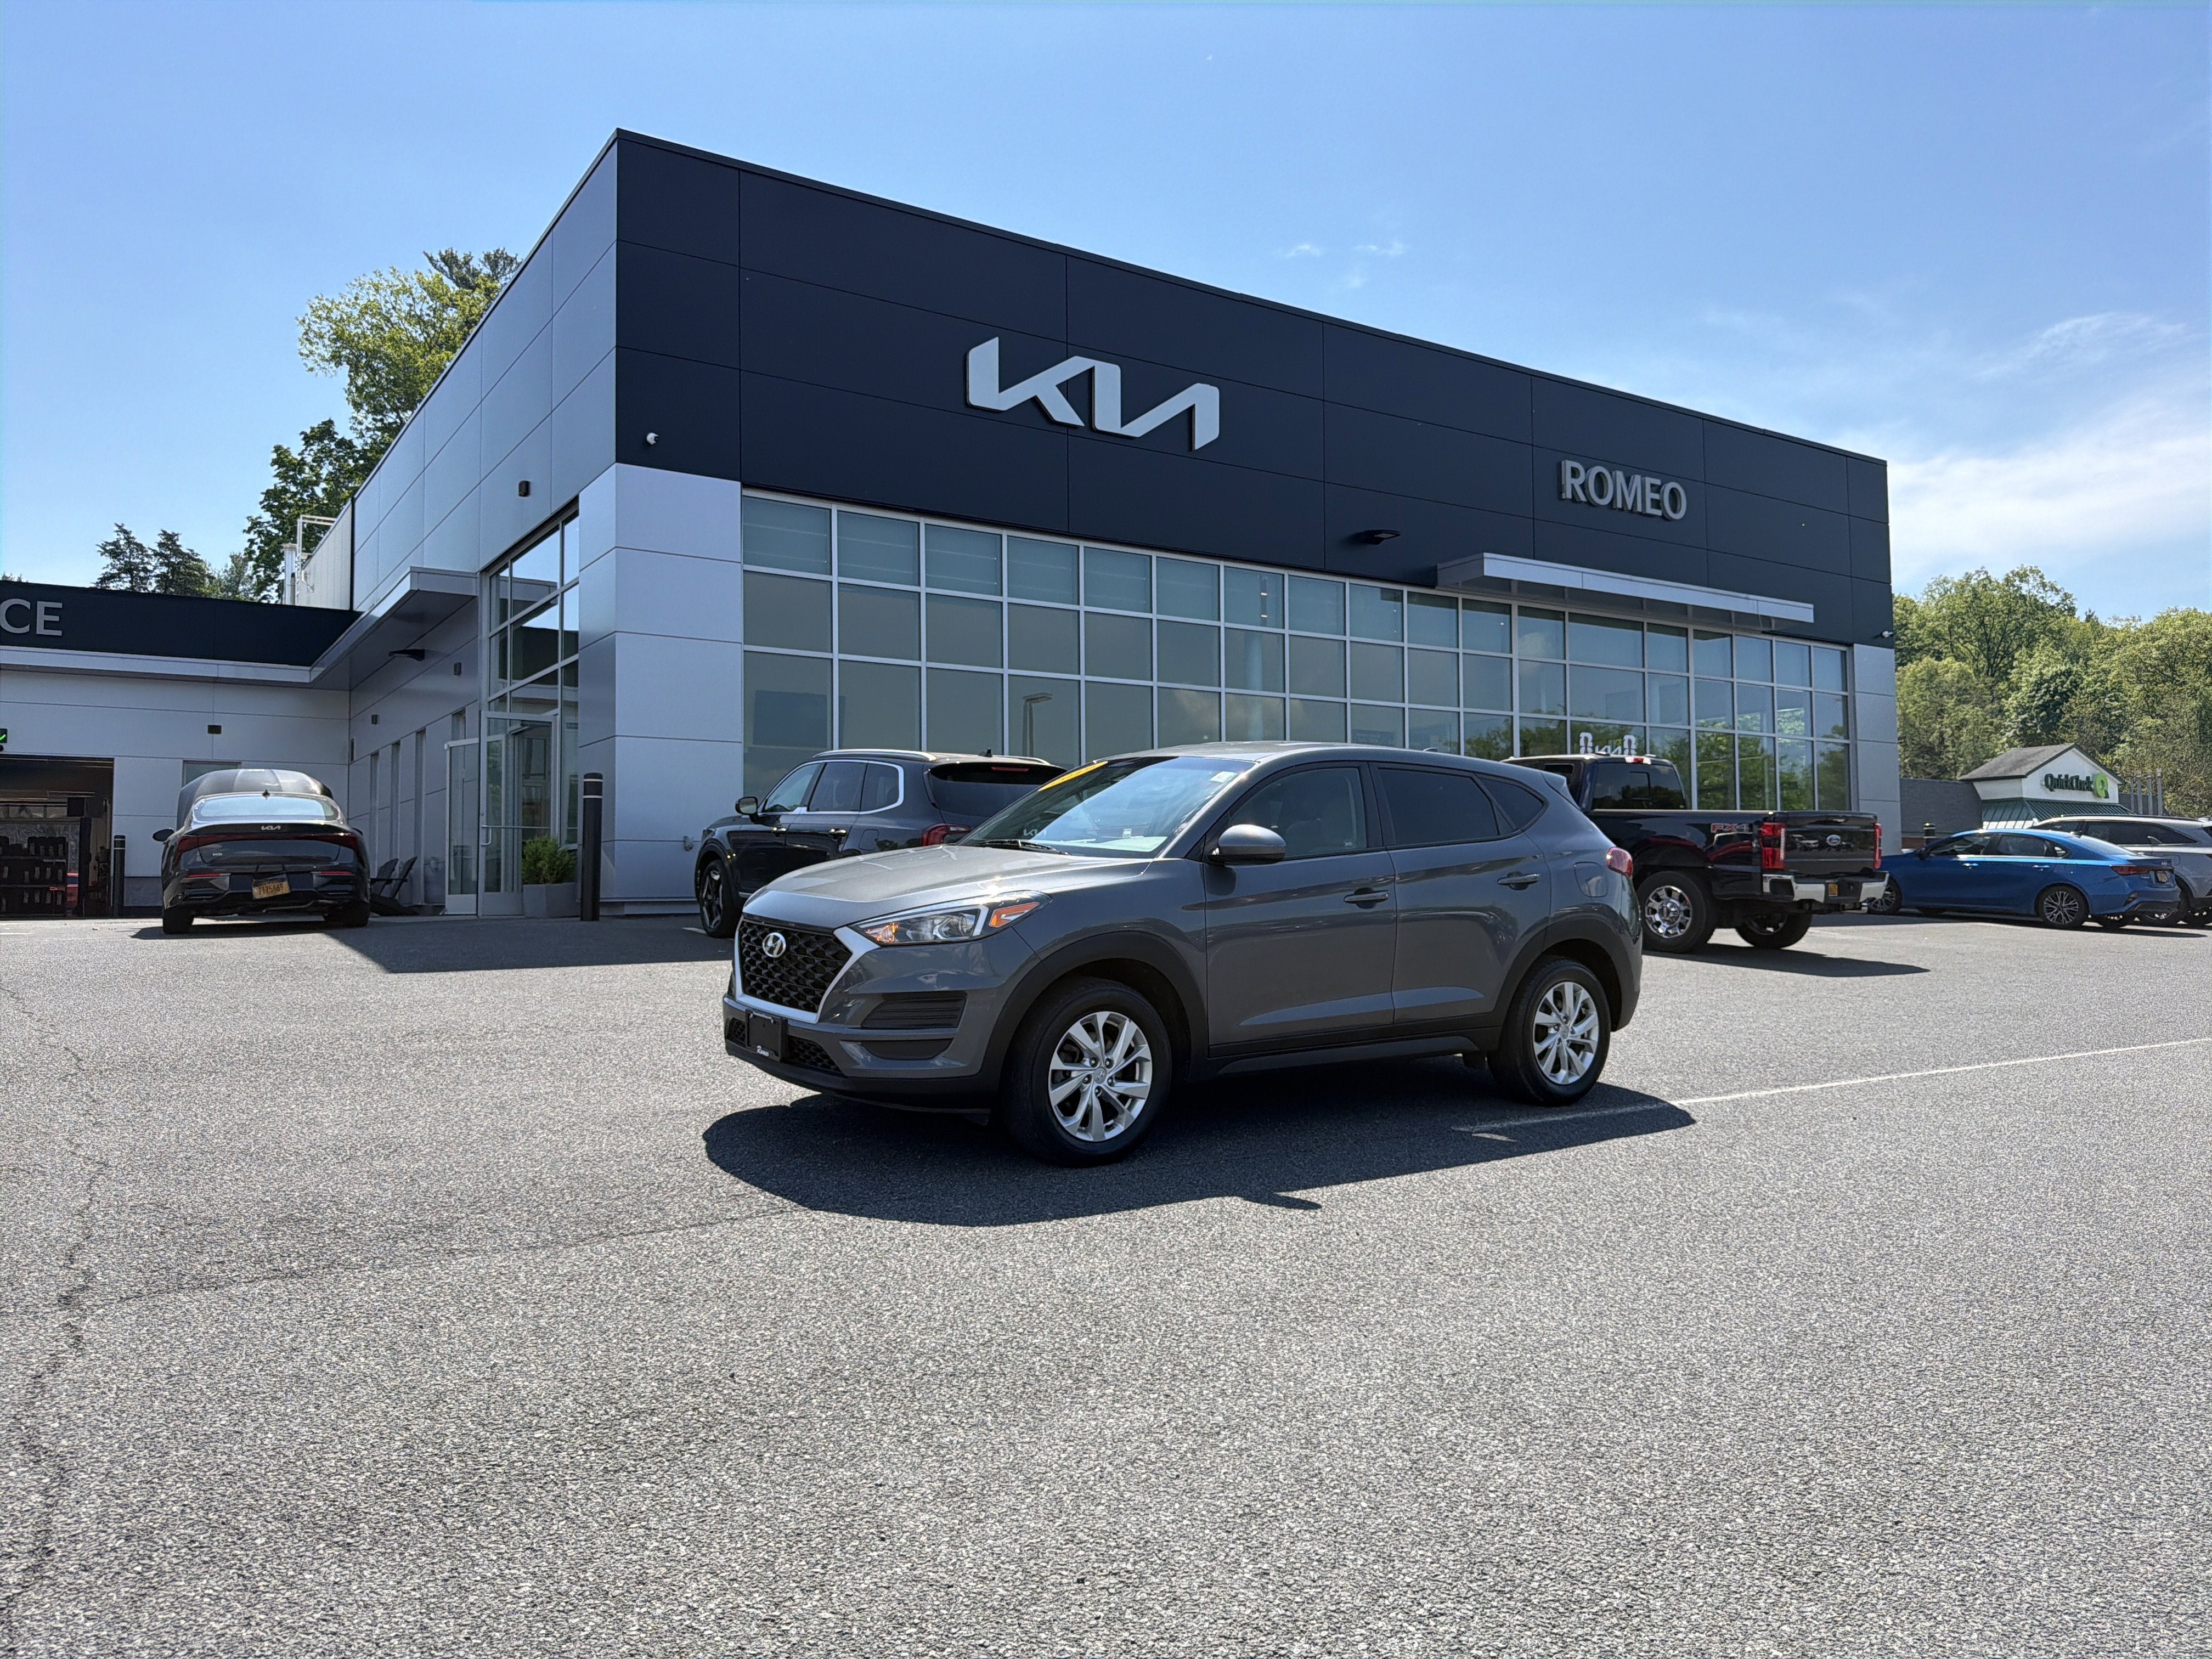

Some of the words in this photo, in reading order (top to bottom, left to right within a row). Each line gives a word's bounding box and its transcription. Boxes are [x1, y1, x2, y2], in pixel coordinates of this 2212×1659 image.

[966, 336, 1220, 450] KIA
[1561, 459, 1687, 521] ROMEO
[0, 598, 63, 636] CE
[1711, 823, 1750, 833] FX4
